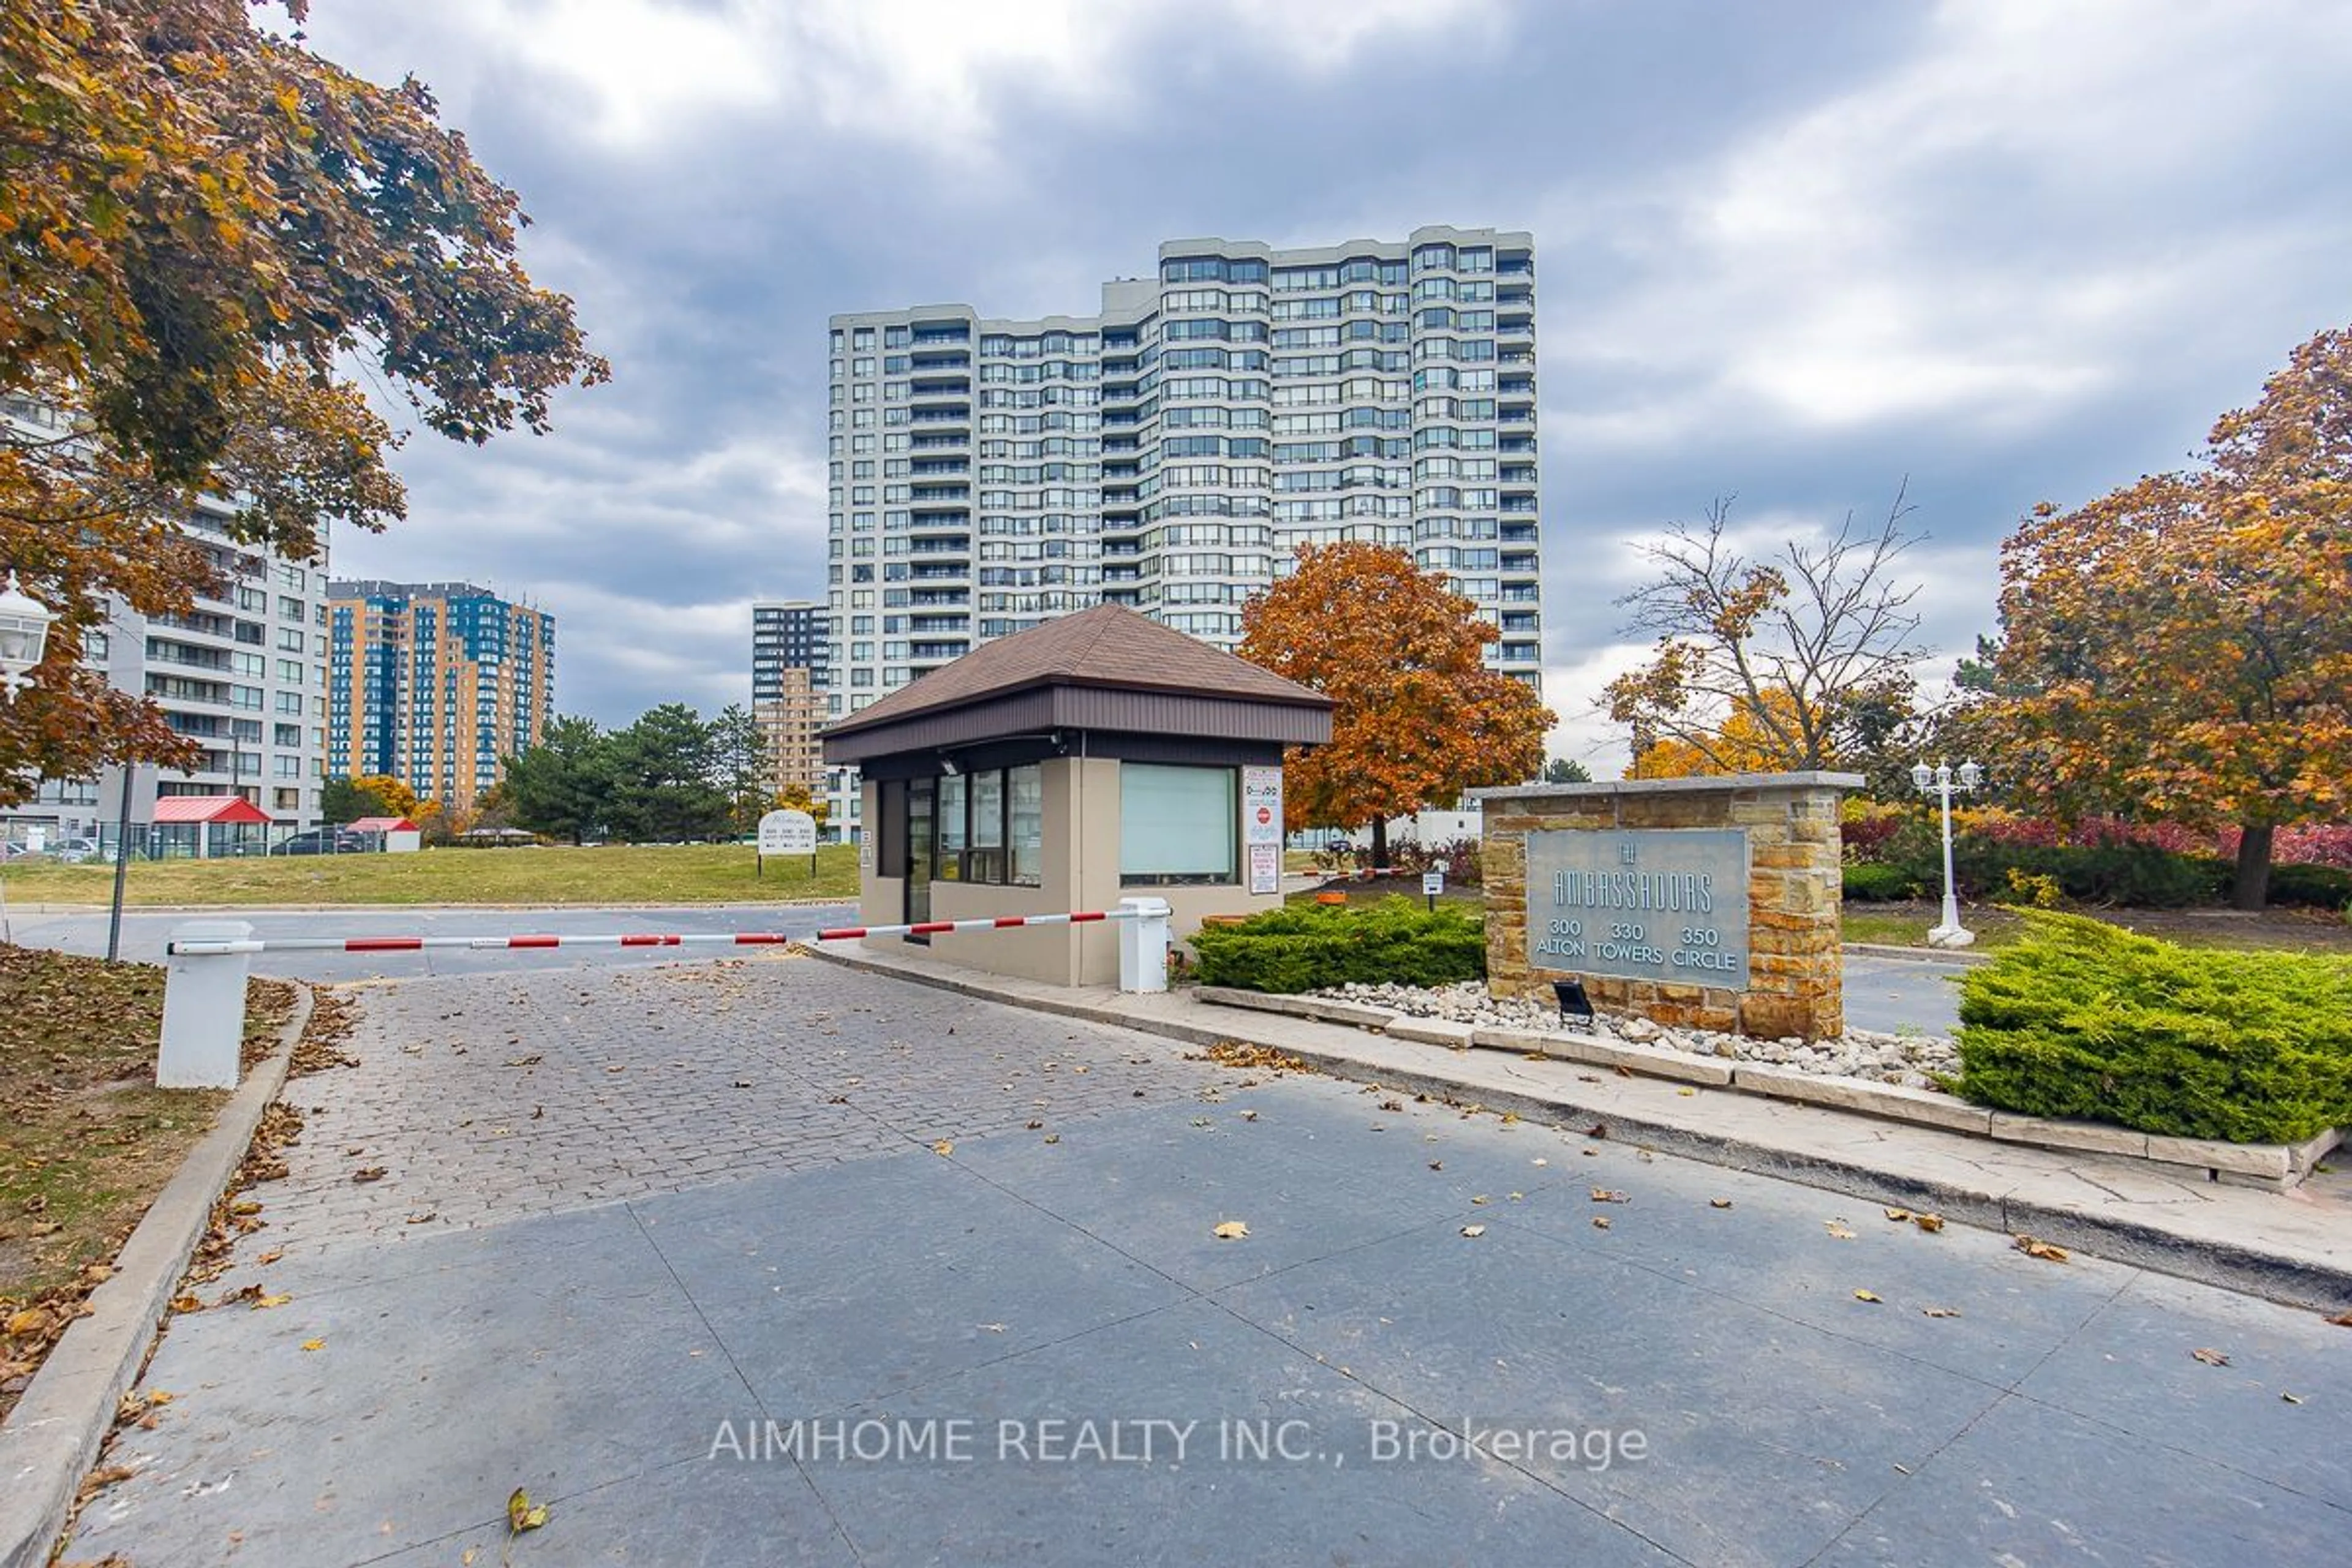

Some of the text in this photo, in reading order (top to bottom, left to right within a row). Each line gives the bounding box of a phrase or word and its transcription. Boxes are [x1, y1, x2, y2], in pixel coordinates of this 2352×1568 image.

[1549, 919, 1719, 946] 300 330 350
[1536, 938, 1736, 971] ALTON TOWERS CIRCLE
